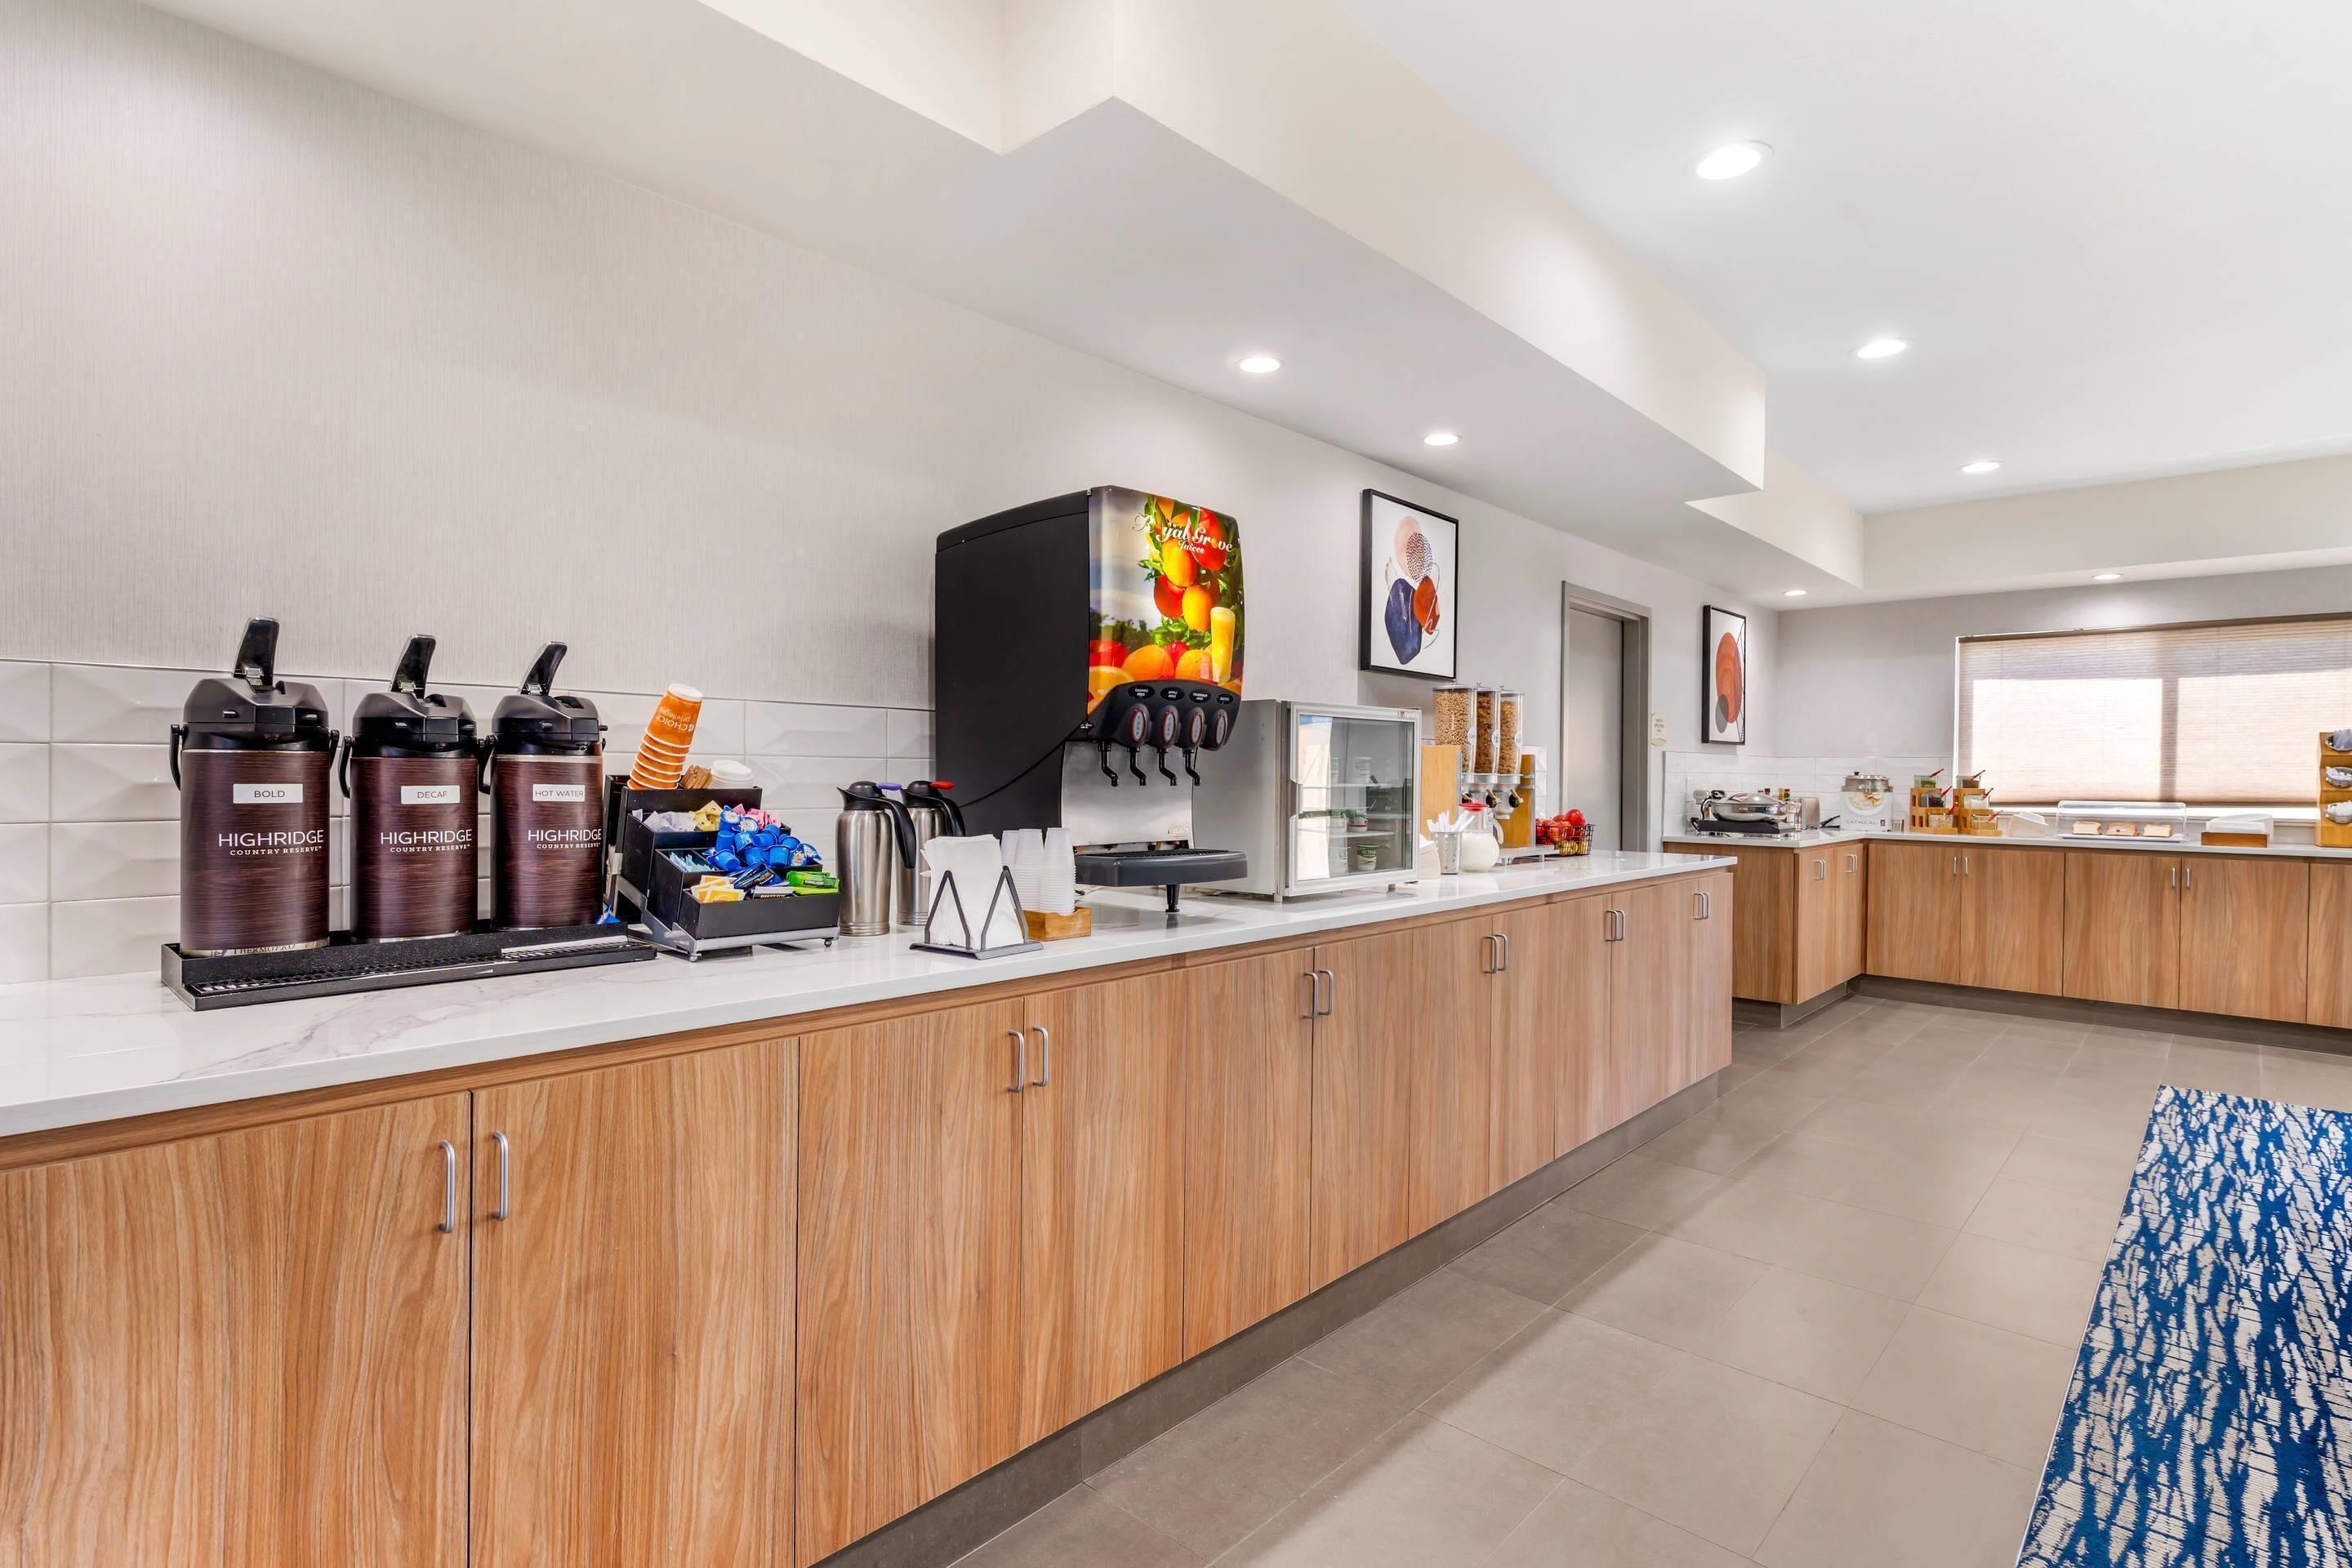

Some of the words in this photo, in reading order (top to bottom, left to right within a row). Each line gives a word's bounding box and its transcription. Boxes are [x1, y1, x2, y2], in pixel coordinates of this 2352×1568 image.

[1177, 539, 1205, 555] Juices
[656, 713, 688, 732] CHOICE
[253, 790, 286, 799] BOLD
[416, 791, 448, 799] DECAF
[218, 829, 324, 848] HIGHRIDGE
[380, 828, 473, 845] HIGHRIDGE
[527, 828, 602, 842] HIGHRIDGE
[229, 848, 280, 856] COUNTRY
